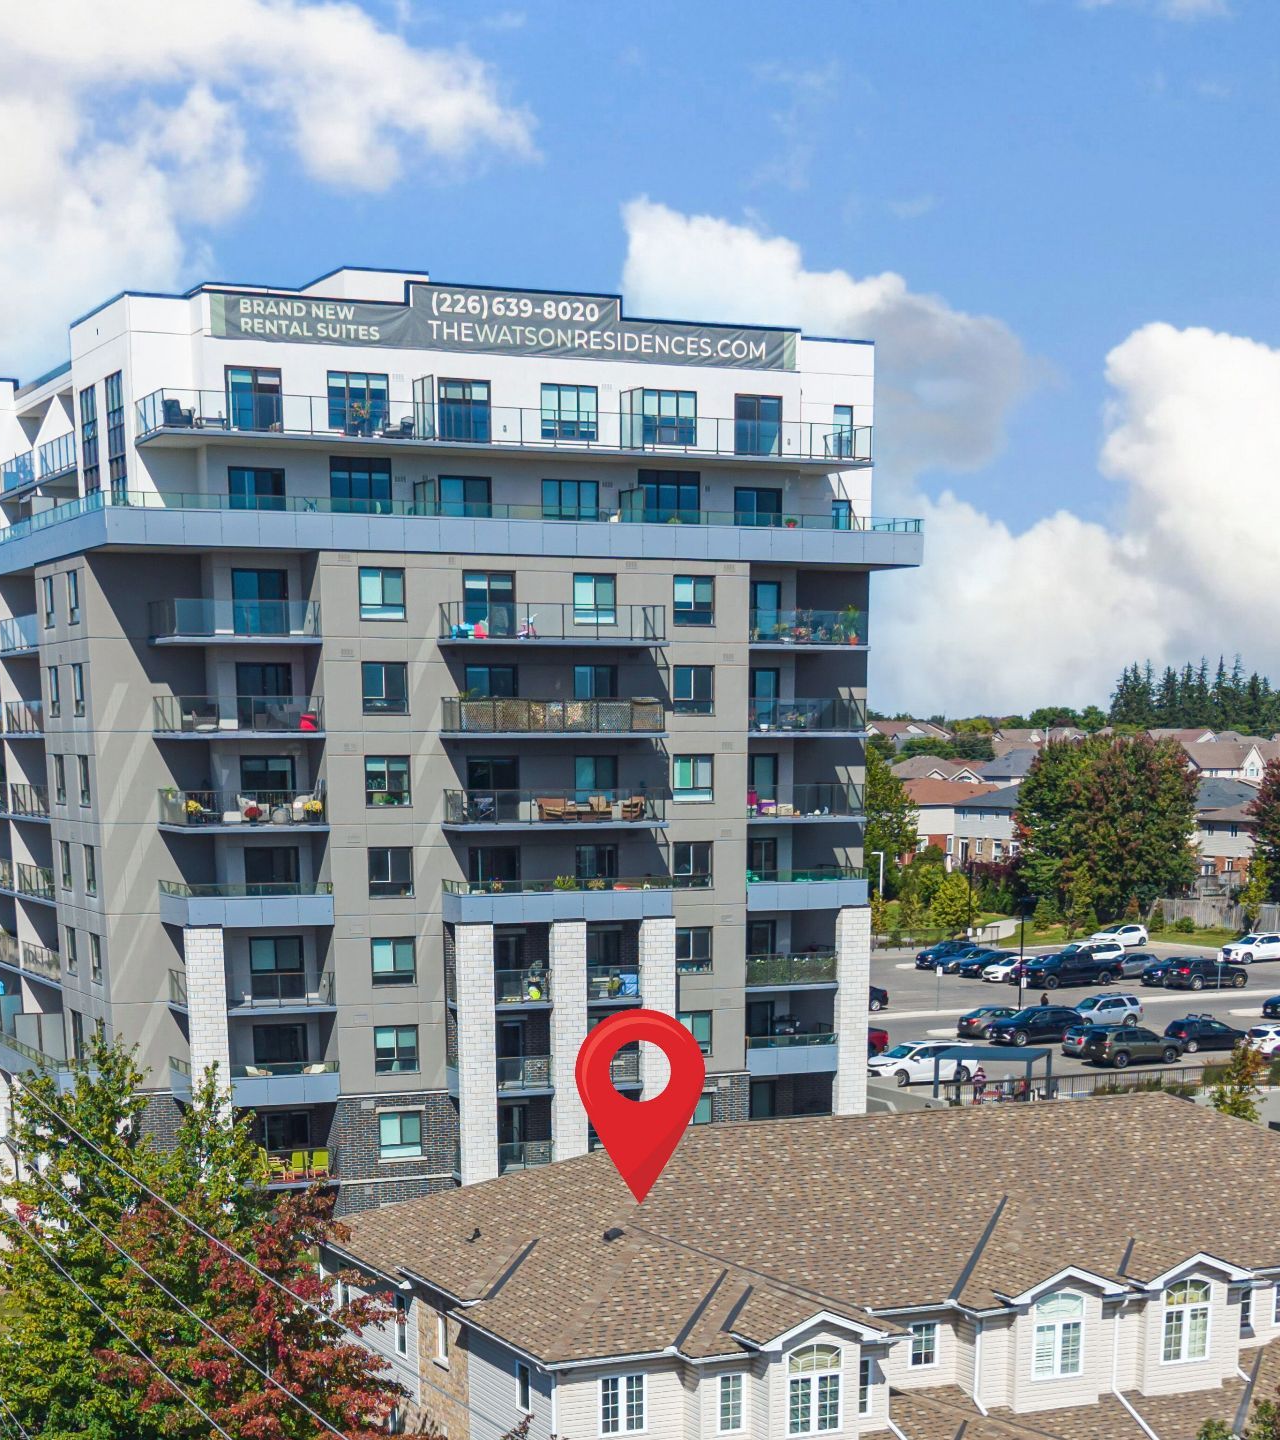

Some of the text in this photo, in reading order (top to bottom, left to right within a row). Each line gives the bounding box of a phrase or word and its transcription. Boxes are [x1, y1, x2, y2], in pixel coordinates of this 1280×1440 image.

[239, 299, 355, 321] BRAND NEW
[240, 318, 381, 341] RENTAL SUITES
[427, 320, 768, 361] THEWATSONRESIDENCES.COM
